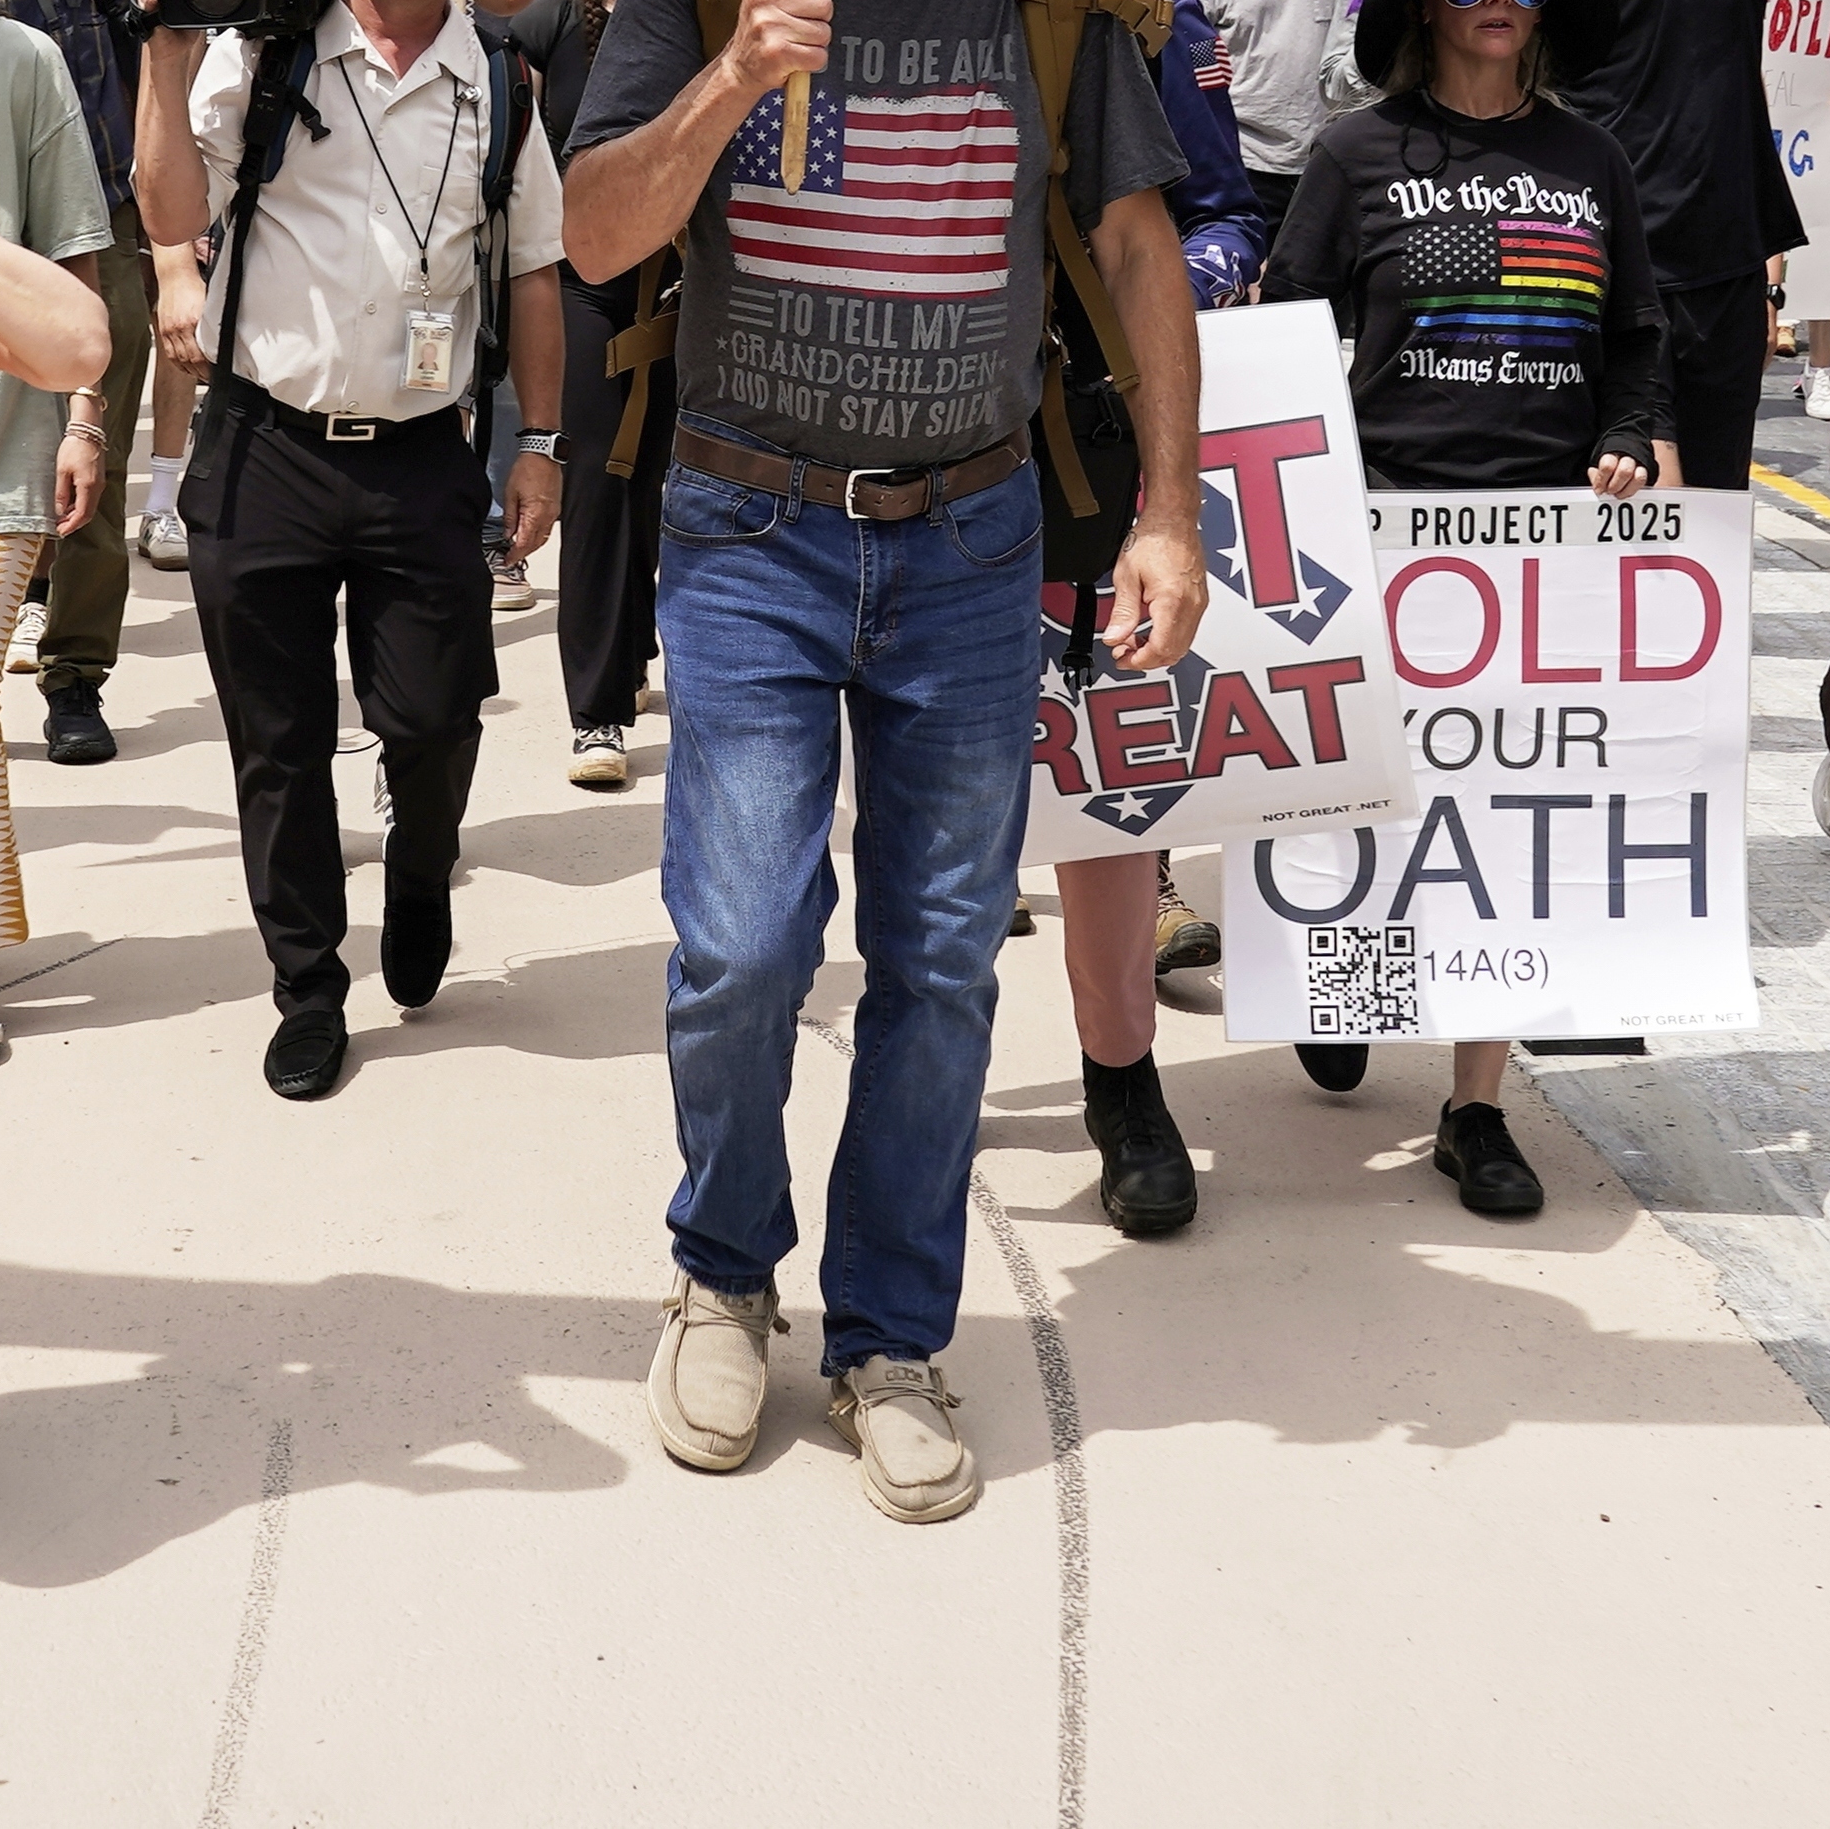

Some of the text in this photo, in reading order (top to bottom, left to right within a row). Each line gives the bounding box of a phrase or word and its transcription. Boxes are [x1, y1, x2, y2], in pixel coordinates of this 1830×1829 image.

[840, 35, 886, 84] TO
[898, 38, 942, 86] BE
[1387, 177, 1456, 220] We
[1457, 174, 1512, 218] the
[776, 288, 966, 351] TO TELL MY
[1399, 347, 1495, 388] Means
[731, 368, 771, 411] DID
[777, 379, 831, 426] NOT
[839, 394, 920, 439] STAY
[1409, 503, 1570, 545] PROJECT
[1596, 502, 1683, 541] 2025
[1262, 799, 1392, 823] NOT GREAT .NET
[1253, 791, 1710, 927] OATH
[1422, 946, 1551, 989] 14A(3)
[1620, 1015, 1651, 1027] NOT
[1655, 1014, 1706, 1026] GREAT
